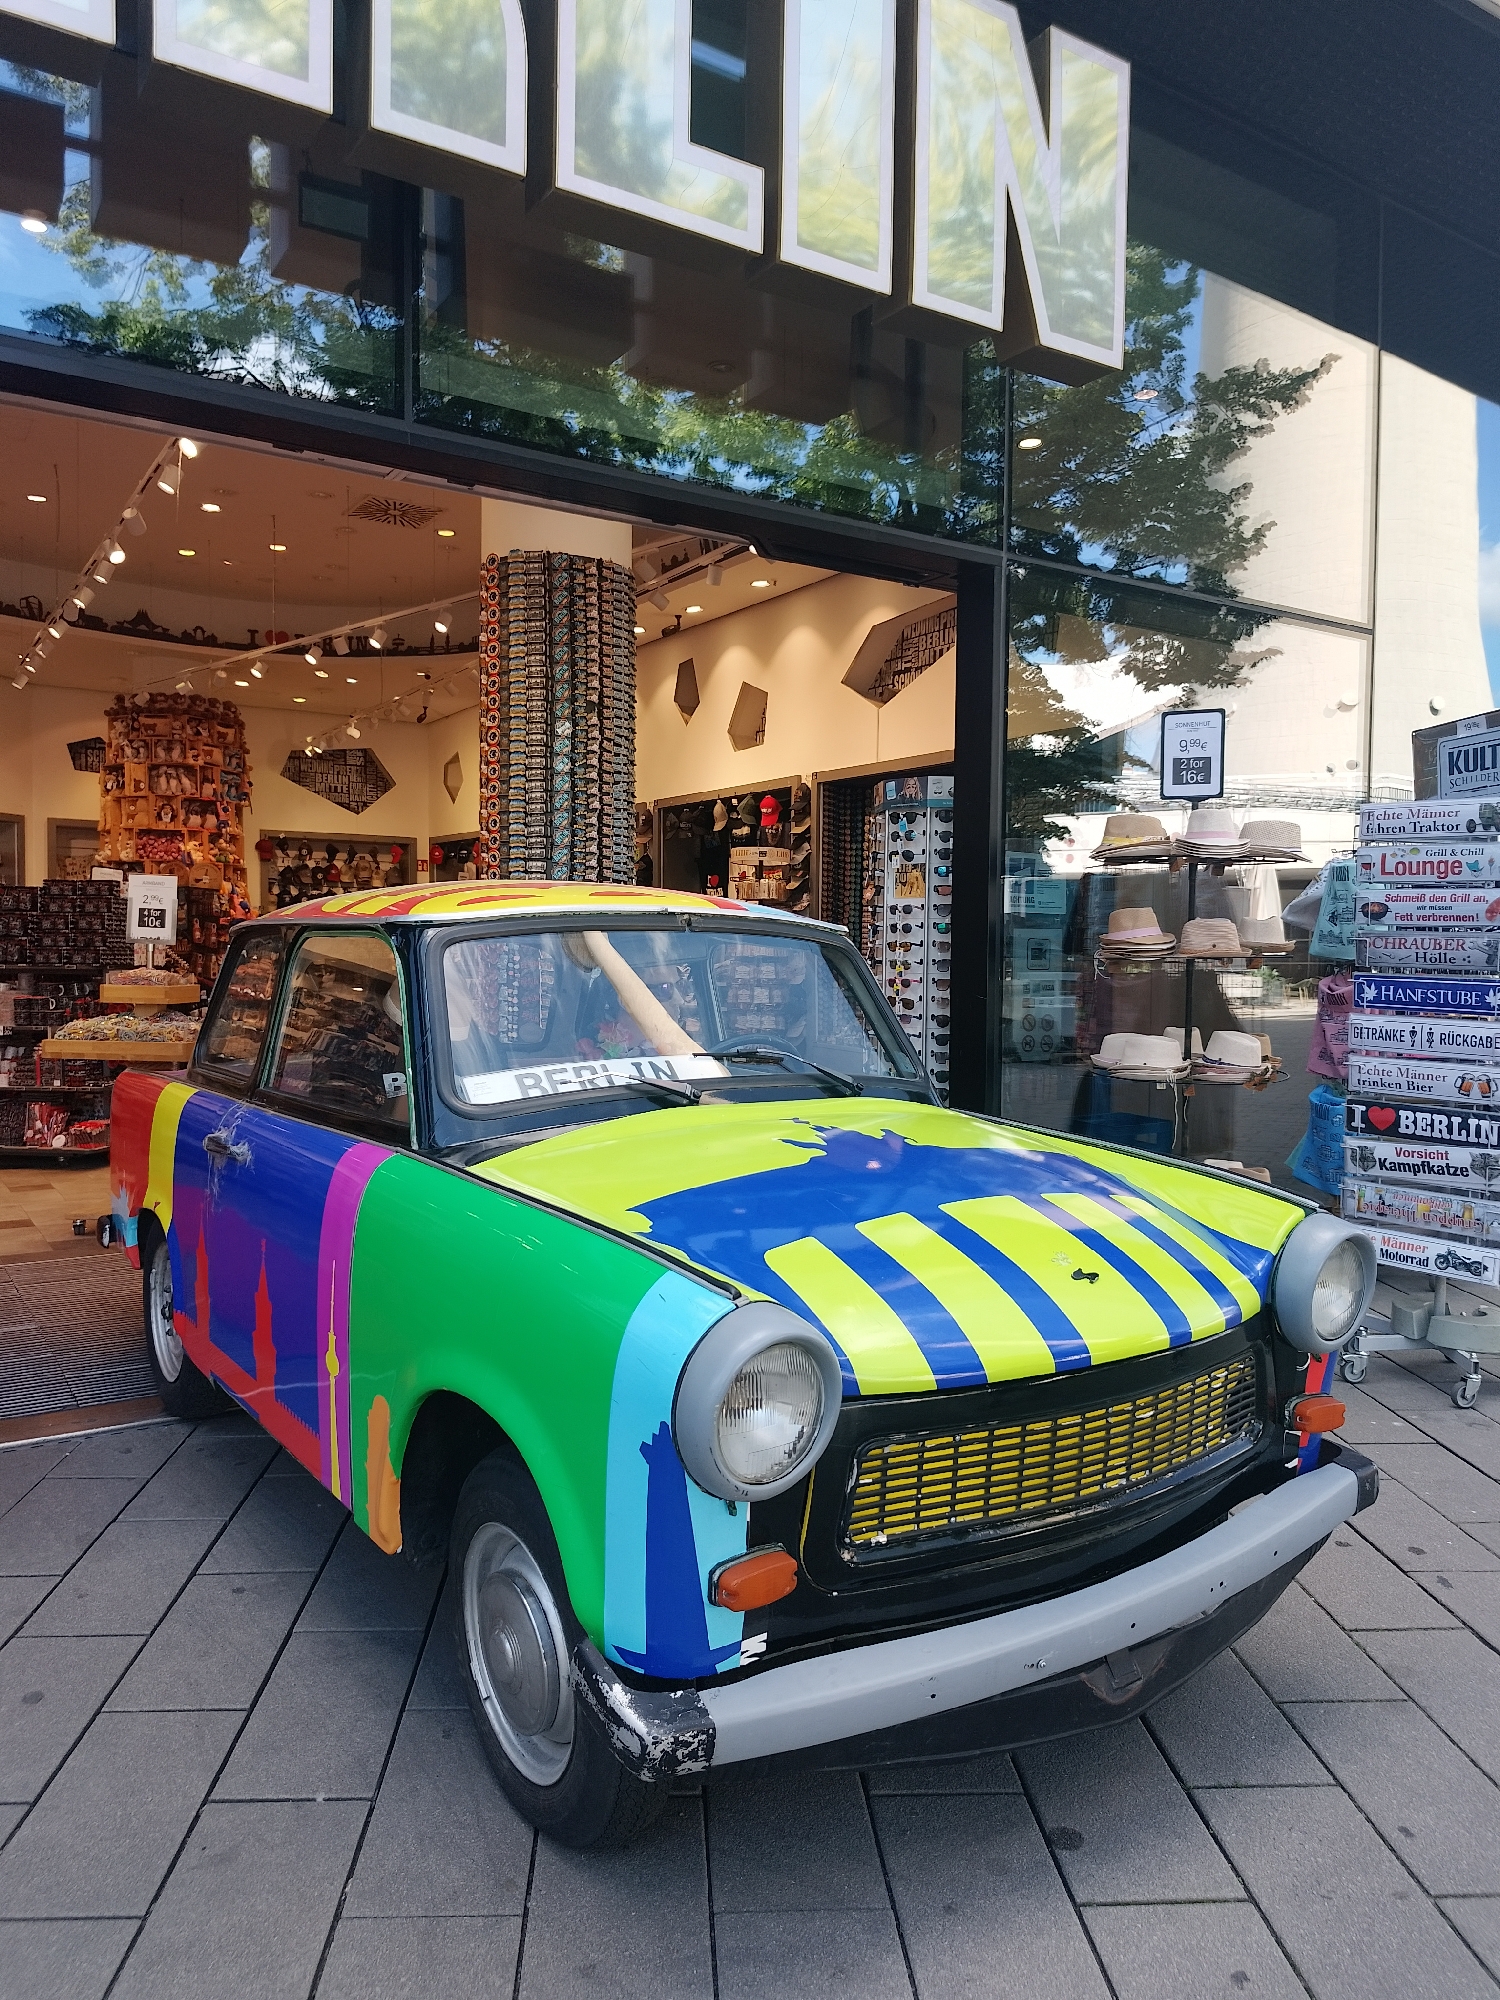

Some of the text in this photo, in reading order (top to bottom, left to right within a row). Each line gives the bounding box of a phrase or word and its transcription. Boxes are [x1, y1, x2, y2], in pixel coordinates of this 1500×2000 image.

[919, 627, 956, 652] BERLIN
[1174, 720, 1211, 728] SONNENHUT
[1179, 738, 1208, 754] 9,99€
[1180, 758, 1205, 769] 2 for
[1448, 743, 1500, 776] KULT
[315, 773, 349, 785] BERLIN
[1180, 769, 1206, 784] 16€
[1449, 771, 1500, 789] SCHILDER
[315, 782, 350, 794] MITTE
[1367, 808, 1461, 821] Echte Männer
[1409, 820, 1461, 833] Traktor
[1425, 847, 1484, 857] Grill & Chill
[1380, 853, 1463, 880] Lounge
[1384, 893, 1489, 904] Schmeiß den Grill an,
[143, 908, 162, 917] 4 for
[1394, 912, 1480, 922] Fett verbrennen!
[143, 916, 162, 928] 10€
[1414, 951, 1457, 964] Hölle
[1380, 985, 1482, 1006] HANFSTUBE
[1353, 1025, 1500, 1050] GETRÄNKE RÜCKGABE
[1357, 1063, 1449, 1083] Echte Männer
[1357, 1077, 1434, 1093] trinken Bier
[1350, 1104, 1367, 1129] I
[1398, 1110, 1500, 1146] BERLIN
[1394, 1147, 1450, 1161] Vorsicht
[1378, 1157, 1470, 1178] Kampfkatze
[1381, 1235, 1429, 1254] Männer
[1380, 1247, 1430, 1268] Motorrad
